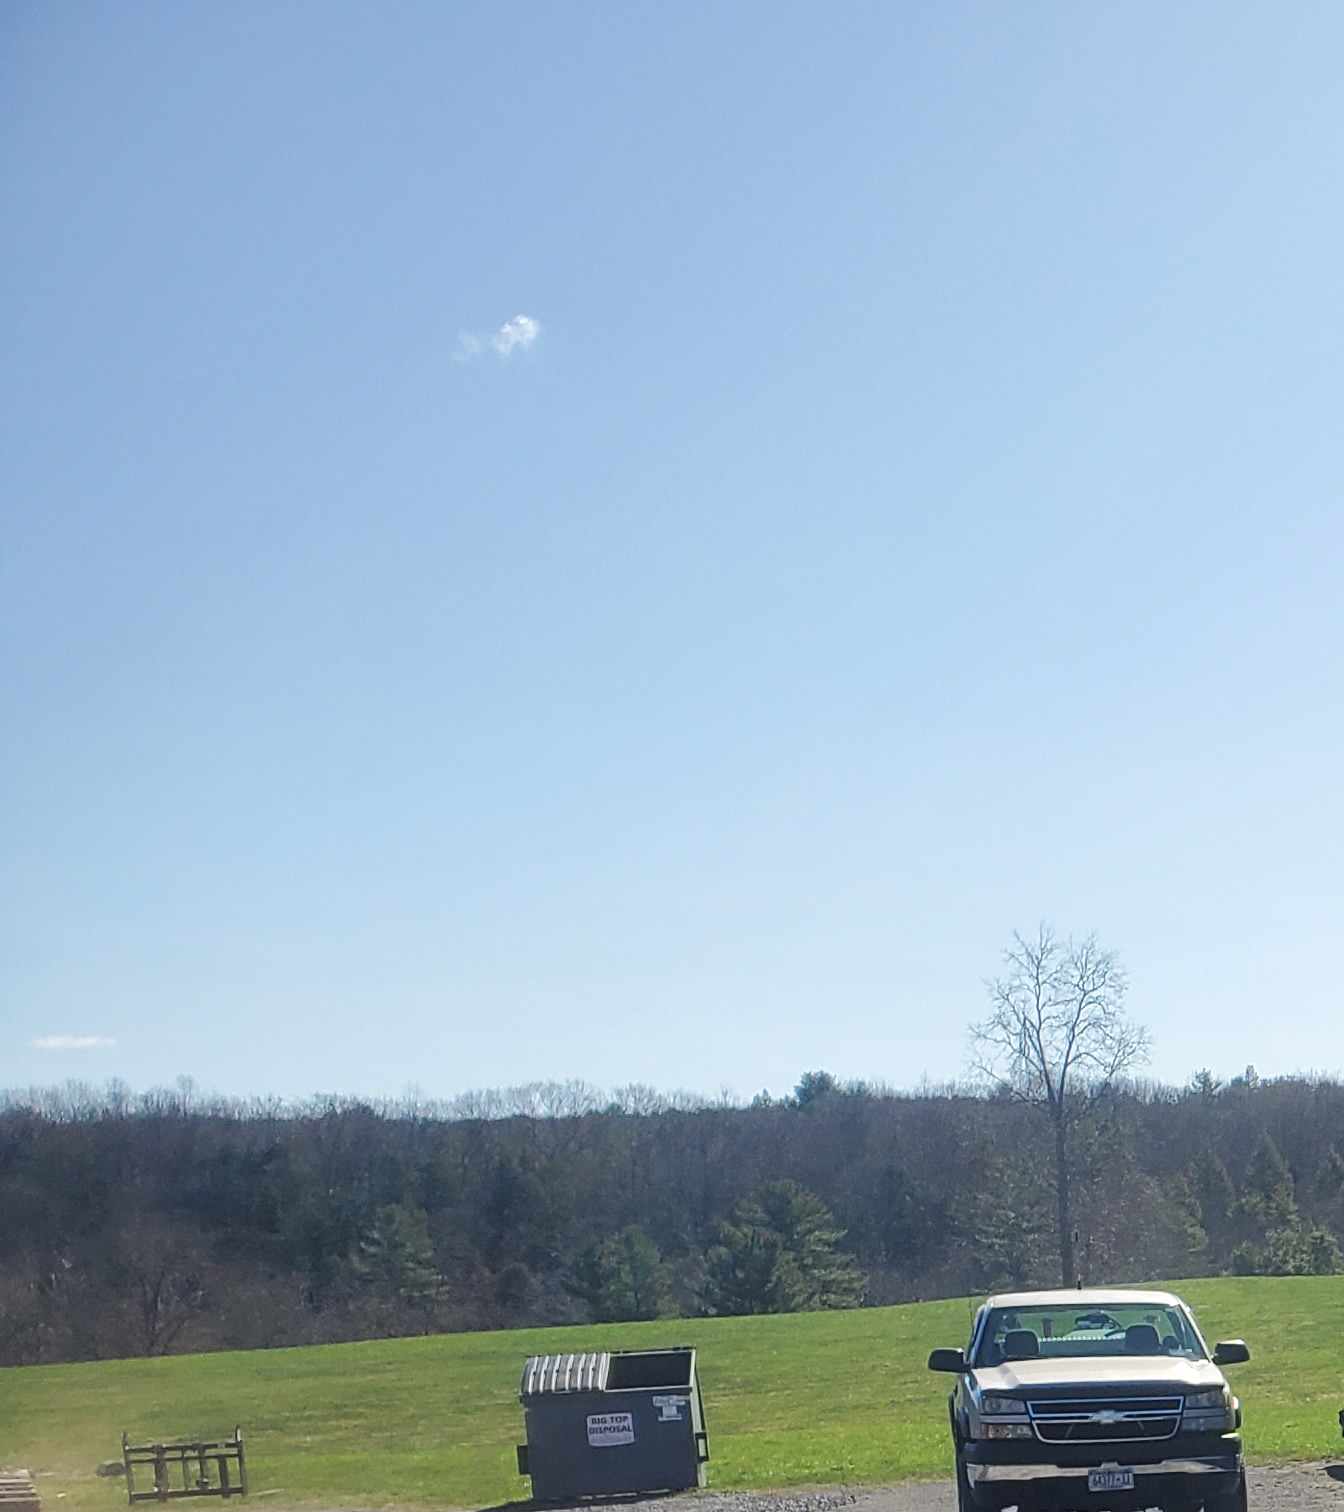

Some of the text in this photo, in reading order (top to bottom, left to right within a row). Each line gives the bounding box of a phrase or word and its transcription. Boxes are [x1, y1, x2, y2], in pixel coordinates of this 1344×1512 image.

[591, 1415, 629, 1425] BIG TOP
[589, 1424, 633, 1435] DISPOSAL
